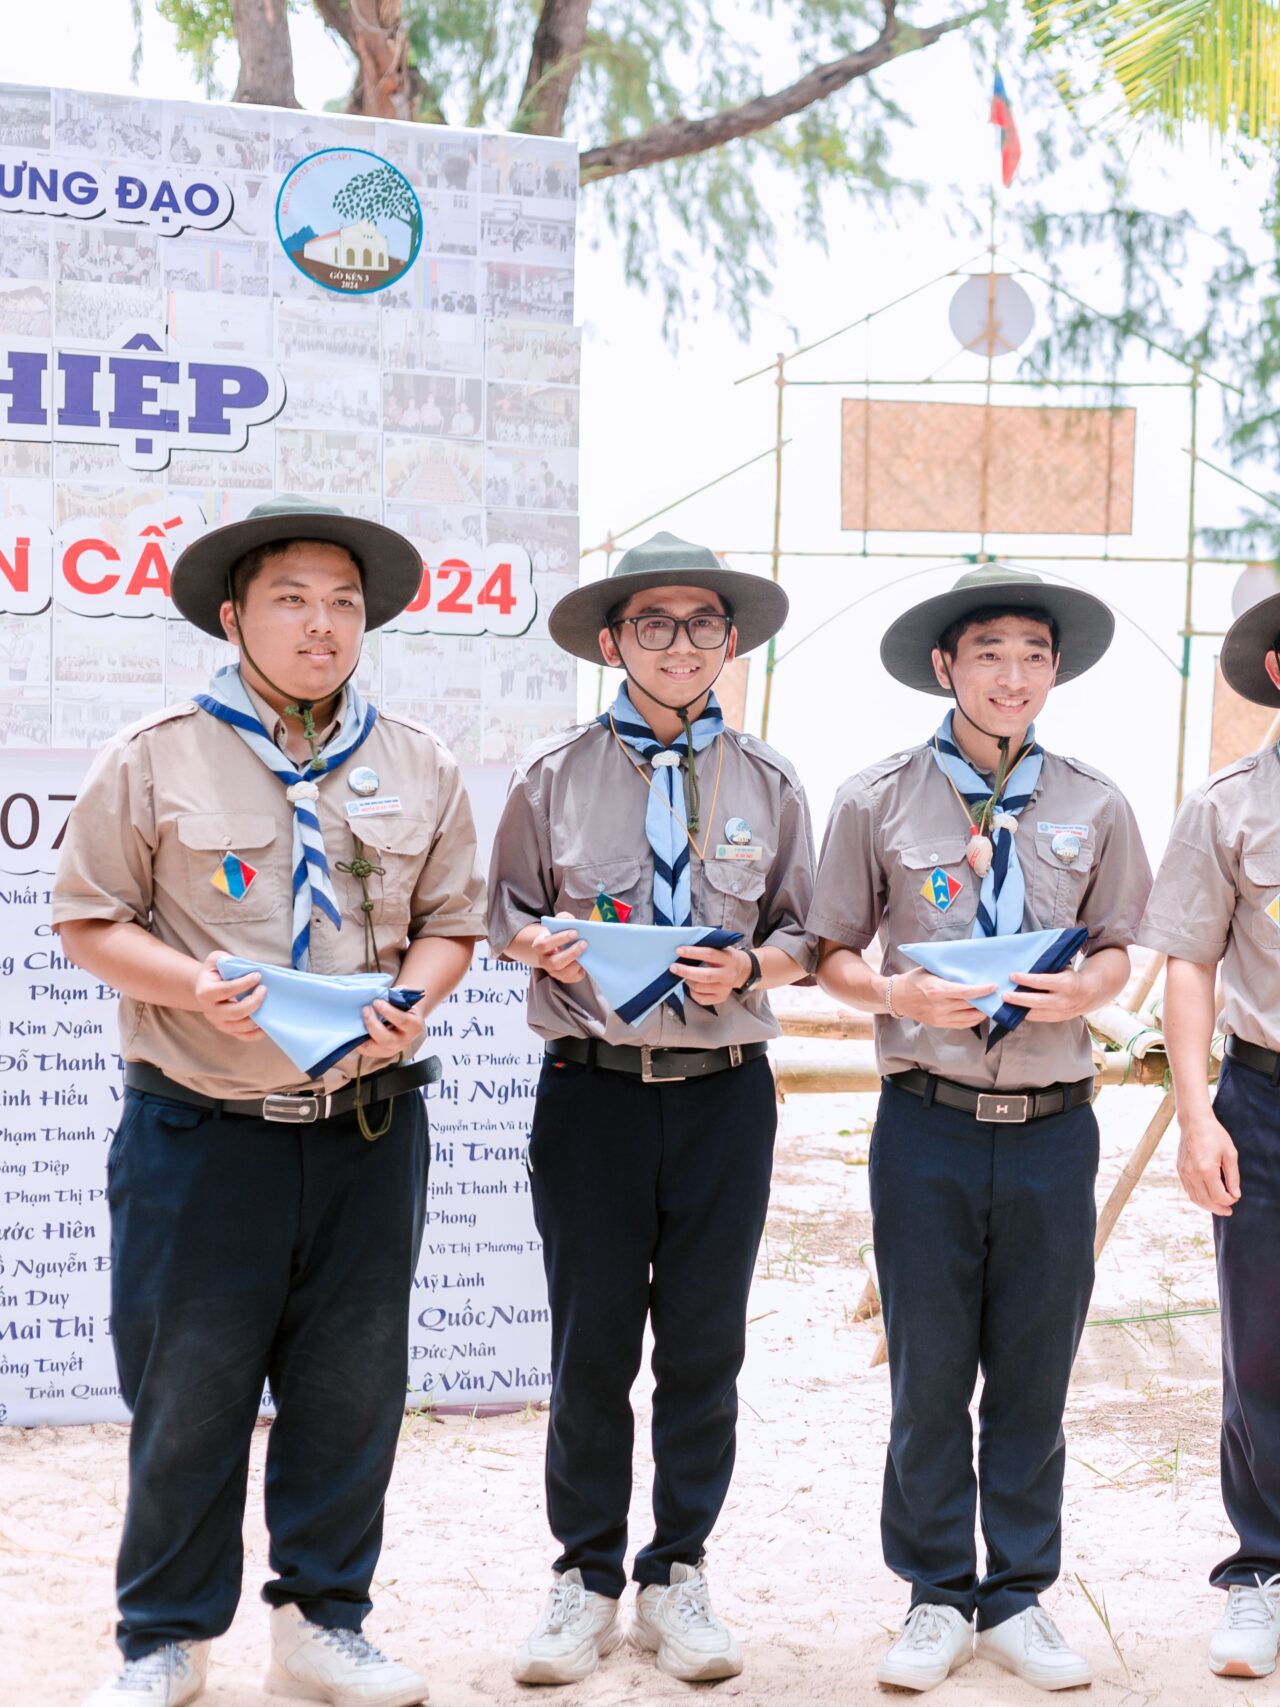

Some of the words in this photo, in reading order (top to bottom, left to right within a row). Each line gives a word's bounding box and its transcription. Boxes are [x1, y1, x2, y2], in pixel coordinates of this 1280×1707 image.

[115, 175, 220, 223] ĐẠO
[62, 515, 188, 597] CẤ
[28, 983, 89, 1005] Phạm
[9, 1020, 46, 1037] Kim
[52, 1019, 103, 1039] Ngân
[459, 1016, 495, 1040] Ân
[33, 1052, 107, 1073] Thanh
[451, 1053, 471, 1067] Võ
[475, 1052, 521, 1066] Phước
[39, 1083, 89, 1107] Hiếu
[0, 1126, 37, 1147] hạm
[40, 1126, 96, 1142] Thanh
[32, 1159, 70, 1177] Diệp
[4, 1189, 51, 1207] Phạm
[53, 1188, 83, 1206] Thị
[456, 1180, 508, 1196] Thanh
[426, 1209, 478, 1229] Phong
[42, 1220, 97, 1241] Hiên
[448, 1241, 472, 1257] Thị
[11, 1251, 88, 1279] Nguyễn
[441, 1272, 486, 1289] Lành
[25, 1289, 70, 1310] Duy
[417, 1298, 487, 1332] Quốc
[486, 1304, 550, 1330] Nam
[47, 1315, 95, 1343] Thị
[448, 1341, 497, 1361] Nhân
[33, 1351, 85, 1377] Tuyết
[24, 1380, 66, 1400] Trần
[439, 1369, 486, 1392] Văn
[486, 1366, 553, 1393] Nhân
